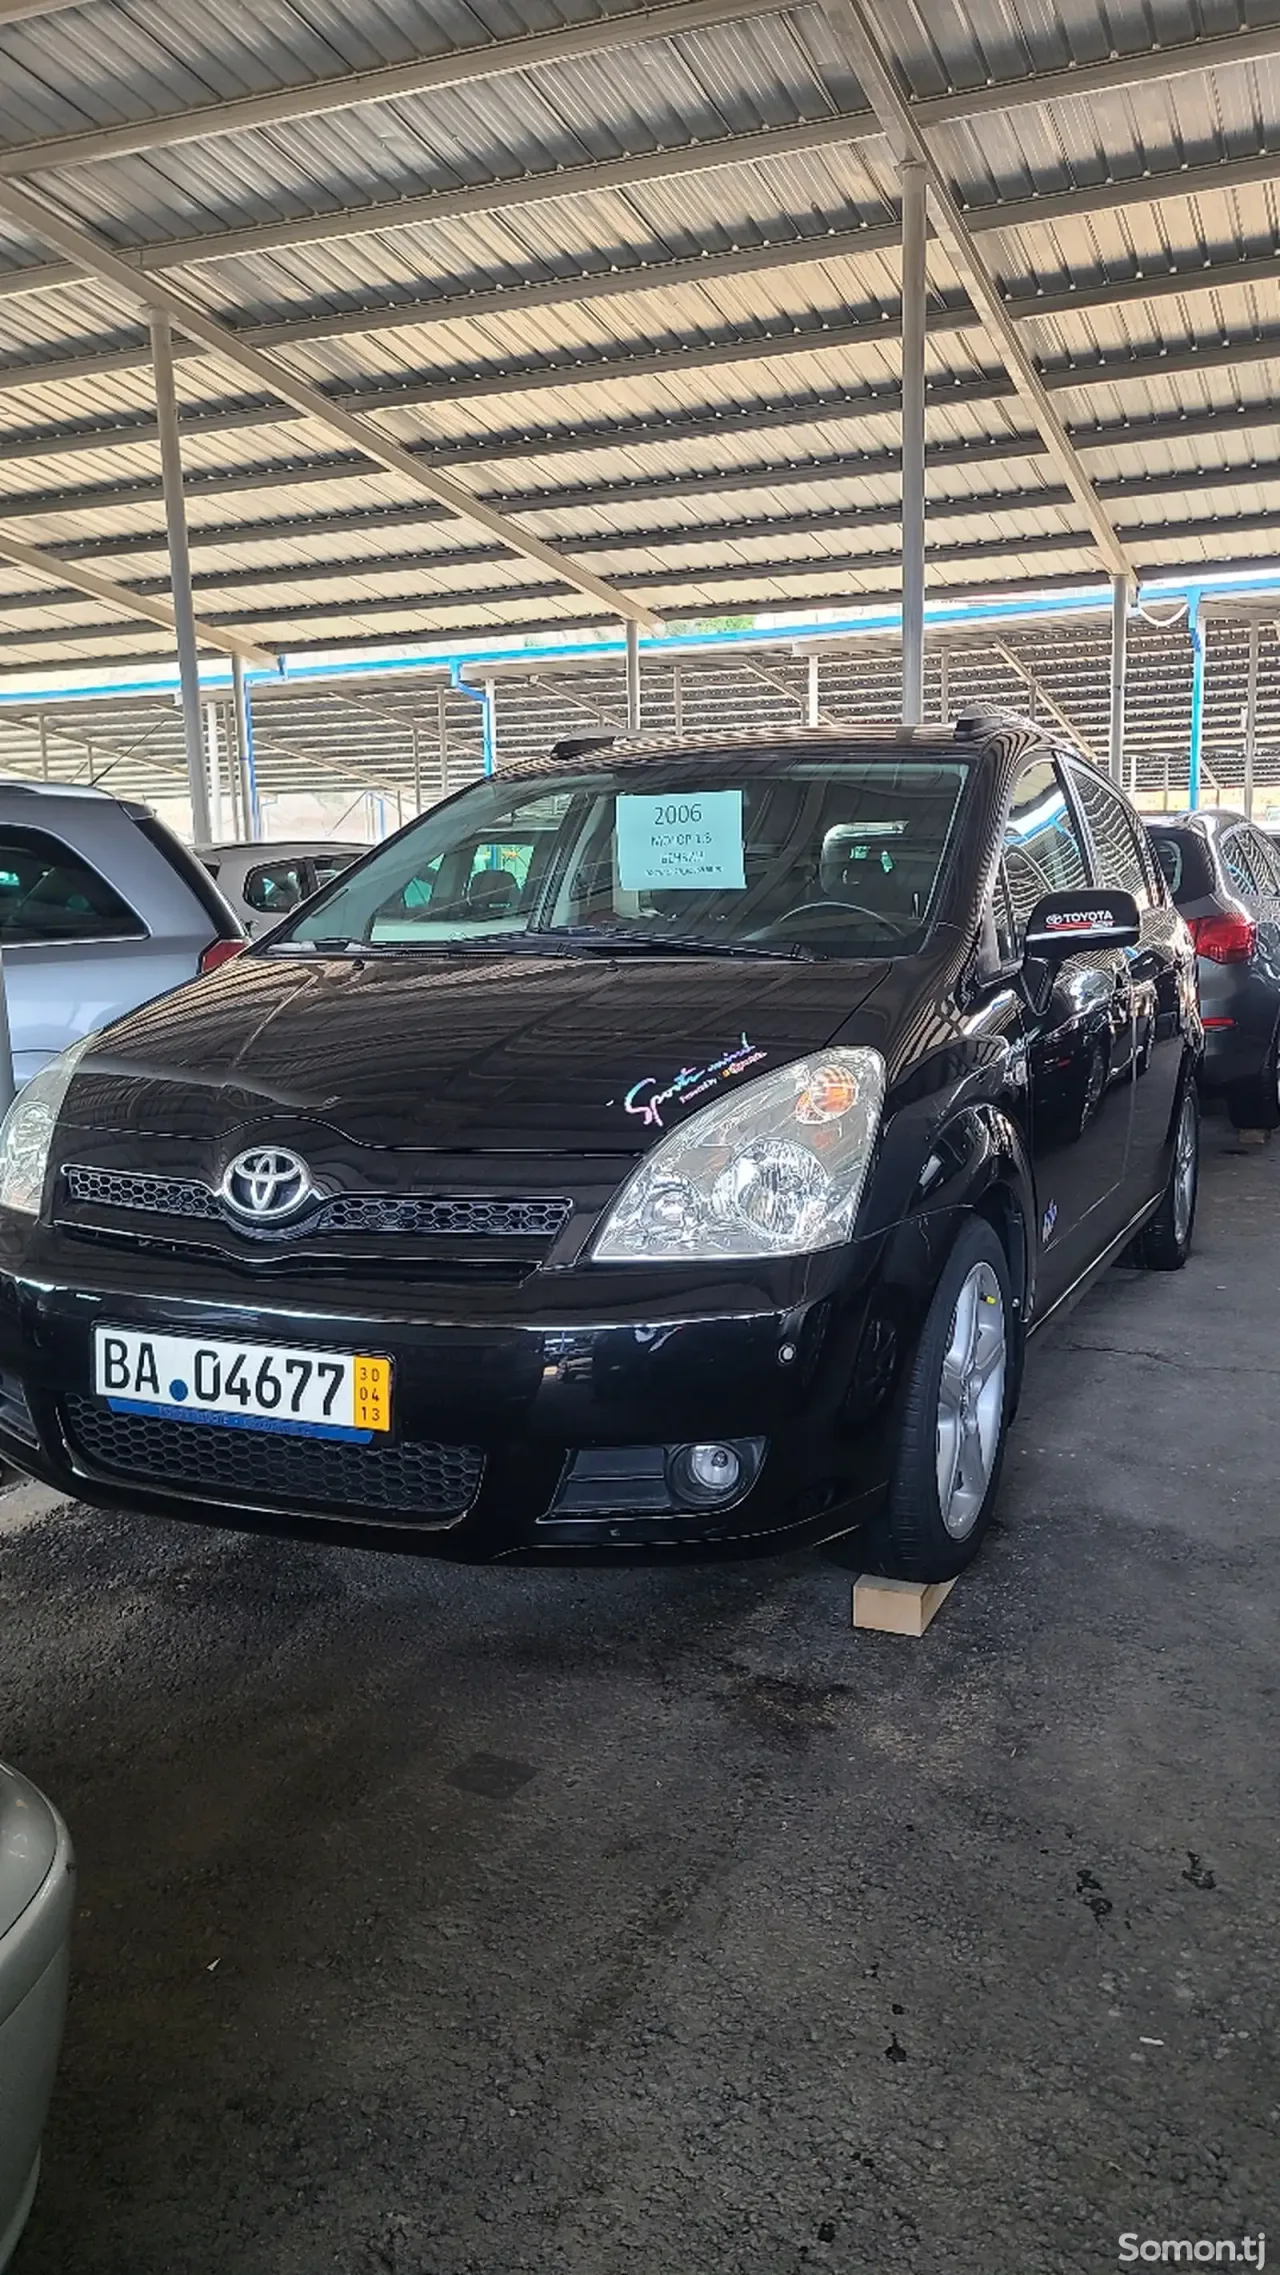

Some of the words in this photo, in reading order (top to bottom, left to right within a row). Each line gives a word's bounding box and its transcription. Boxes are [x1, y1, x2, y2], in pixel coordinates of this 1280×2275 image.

[654, 803, 702, 826] 2006
[1063, 910, 1113, 923] TOYOTA
[104, 1338, 160, 1394] BA
[194, 1349, 345, 1416] 04677
[360, 1367, 380, 1382] 30
[360, 1386, 380, 1402] 04
[361, 1406, 380, 1421] 13
